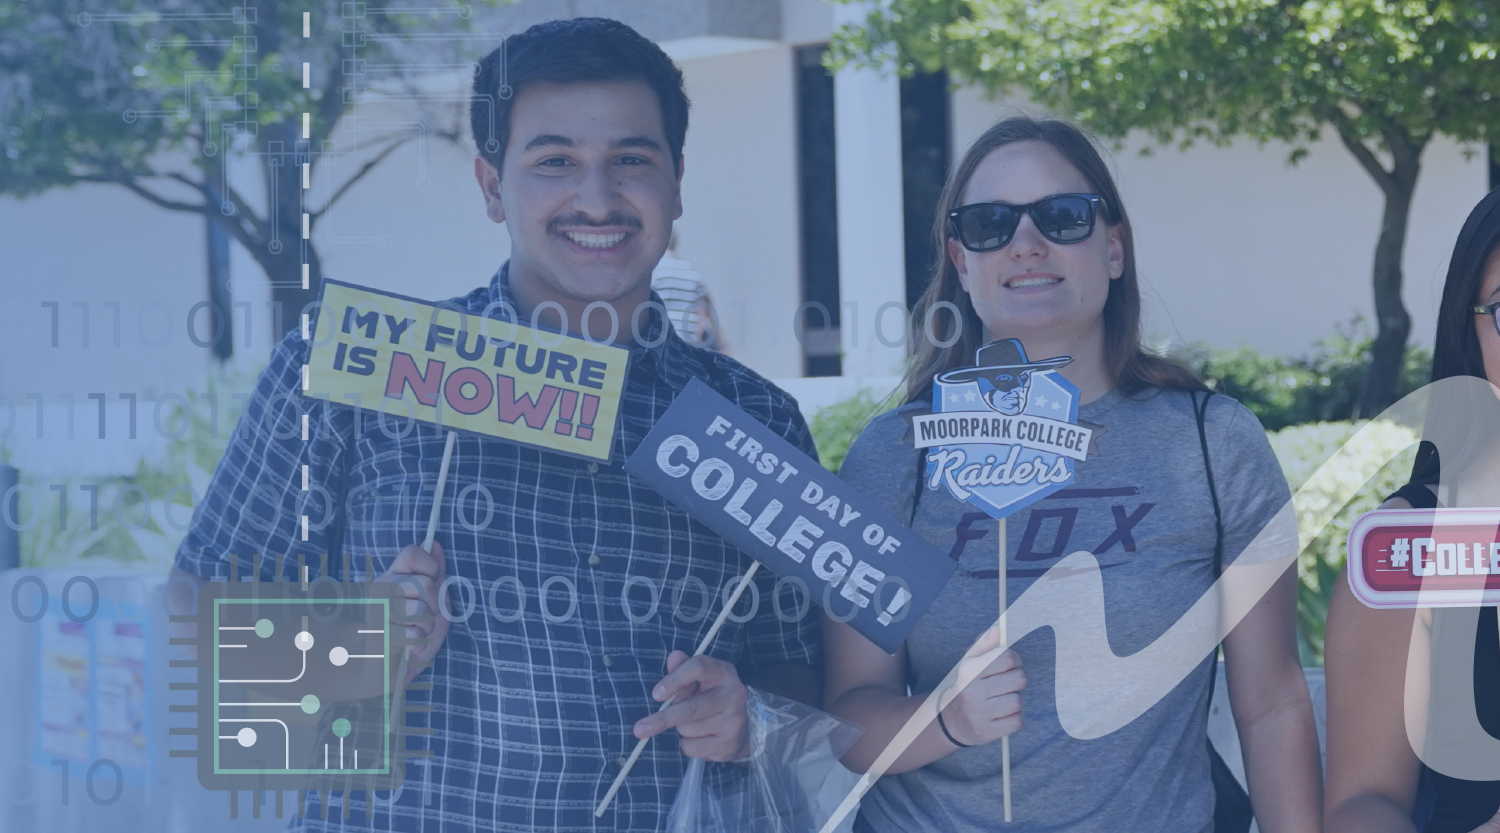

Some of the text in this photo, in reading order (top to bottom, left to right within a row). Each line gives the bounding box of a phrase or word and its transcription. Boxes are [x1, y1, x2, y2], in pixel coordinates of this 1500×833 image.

[341, 306, 607, 390] MY FUTURE
[333, 343, 601, 442] IS NOW!!
[919, 417, 1087, 452] MOORPARK COLLEGE
[705, 415, 902, 555] FIRST DAY OF
[927, 443, 1074, 502] Raiders
[655, 434, 912, 627] COLLEGE!
[948, 503, 1157, 562] FOX
